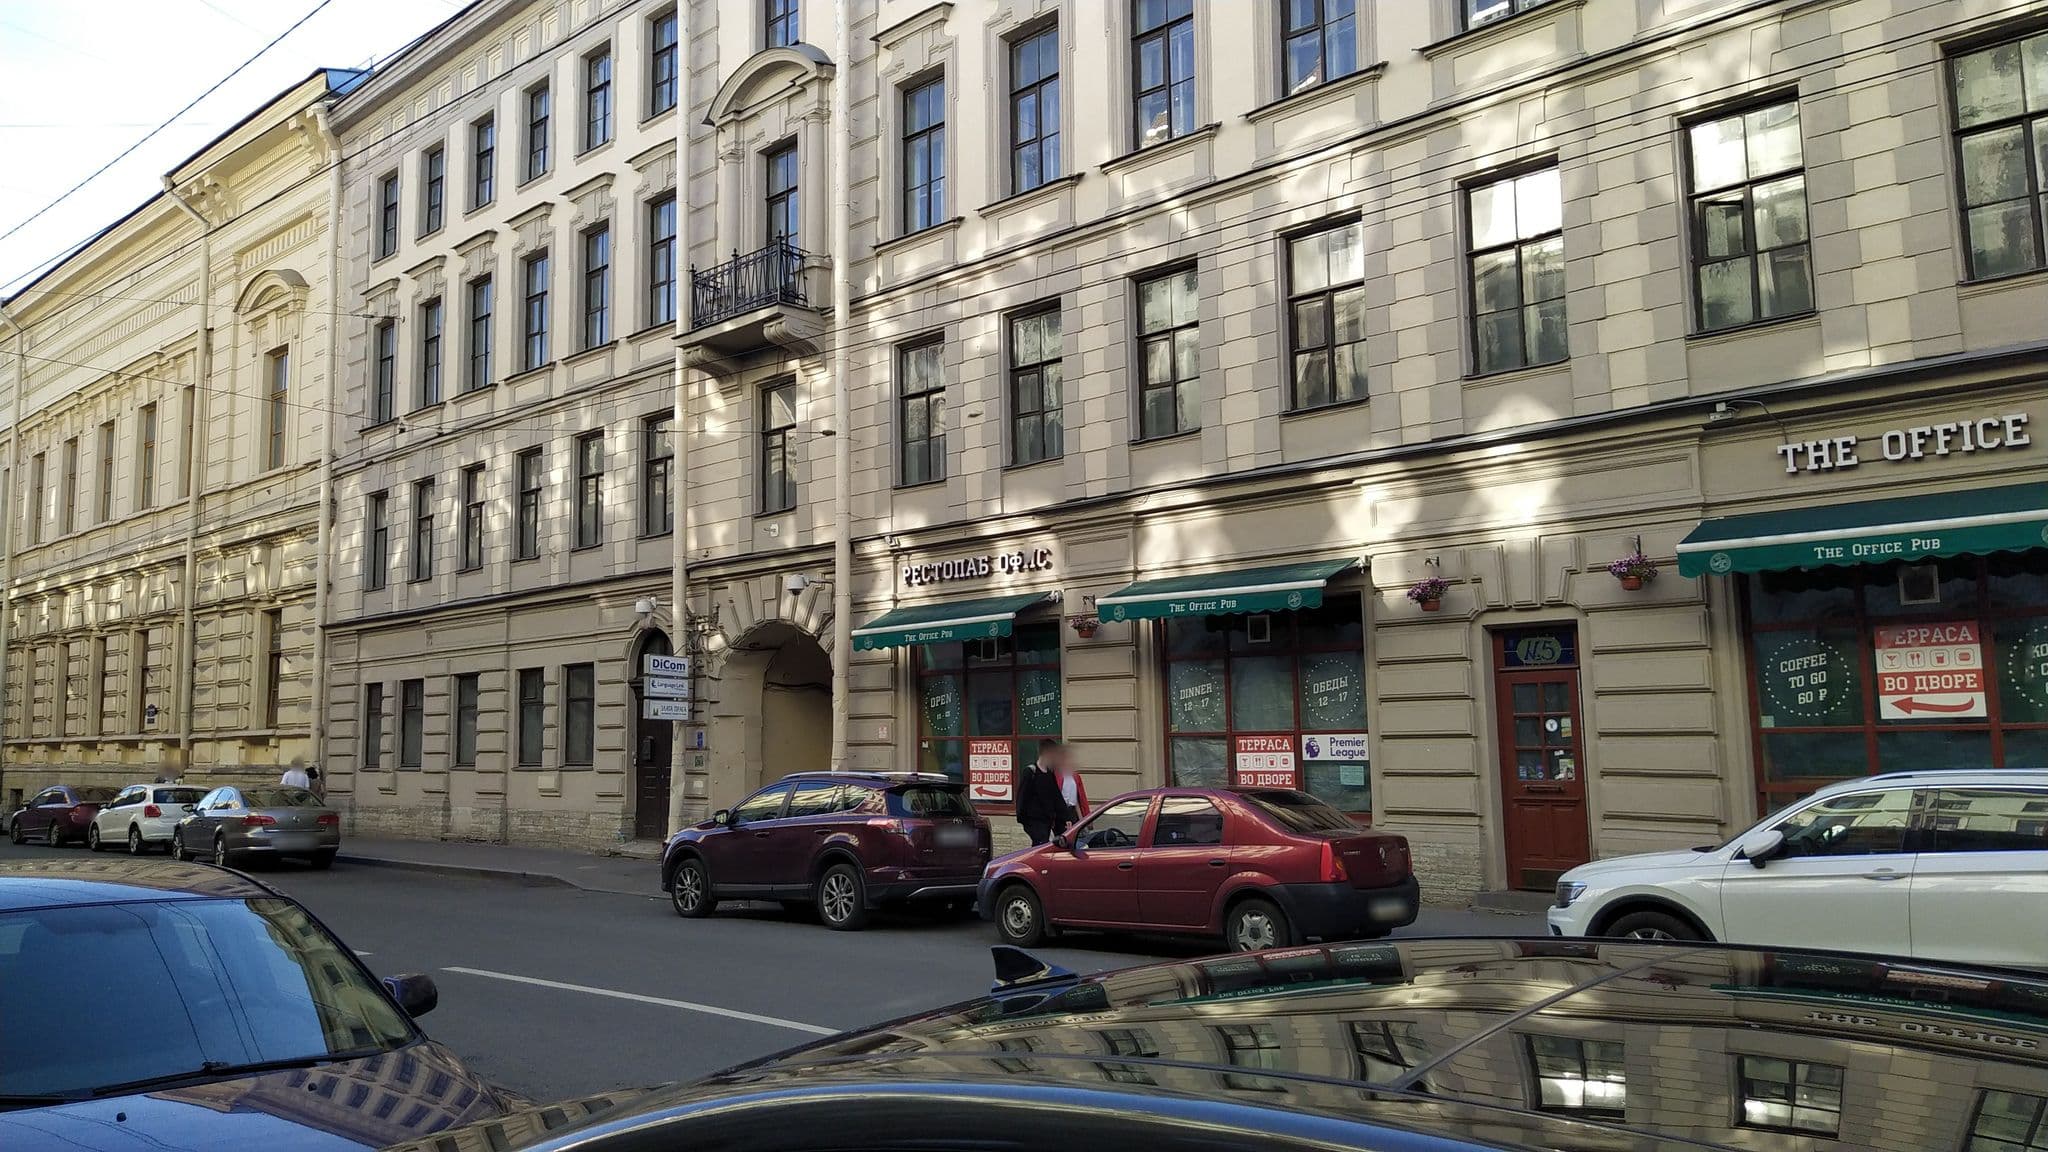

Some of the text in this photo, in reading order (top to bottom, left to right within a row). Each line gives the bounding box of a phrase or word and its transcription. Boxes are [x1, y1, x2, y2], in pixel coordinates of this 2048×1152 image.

[1777, 413, 2030, 473] THE OFFICE
[902, 555, 990, 585] РЕСТОПАБ
[652, 658, 686, 671] DiCom
[1780, 653, 1827, 673] COFFEE
[1313, 676, 1348, 694] ОБЕДЫ
[1788, 671, 1827, 689] TO GO
[1884, 673, 1978, 692] ВО ДВОРЕ
[1179, 683, 1213, 700] DINNER
[1319, 696, 1329, 707] 12
[1338, 691, 1348, 702] 17
[1798, 691, 1814, 705] 60
[930, 692, 952, 708] OPEN
[1184, 701, 1193, 712] 12
[1201, 697, 1210, 708] 17
[972, 743, 1009, 754] ТЕРРАСА
[1239, 739, 1291, 751] ТЕРРАСА
[1329, 736, 1365, 747] Premier
[1330, 748, 1366, 759] League
[971, 772, 1010, 783] ВО ДВОРЕ
[1240, 773, 1292, 786] ВО ДВОРЕ
